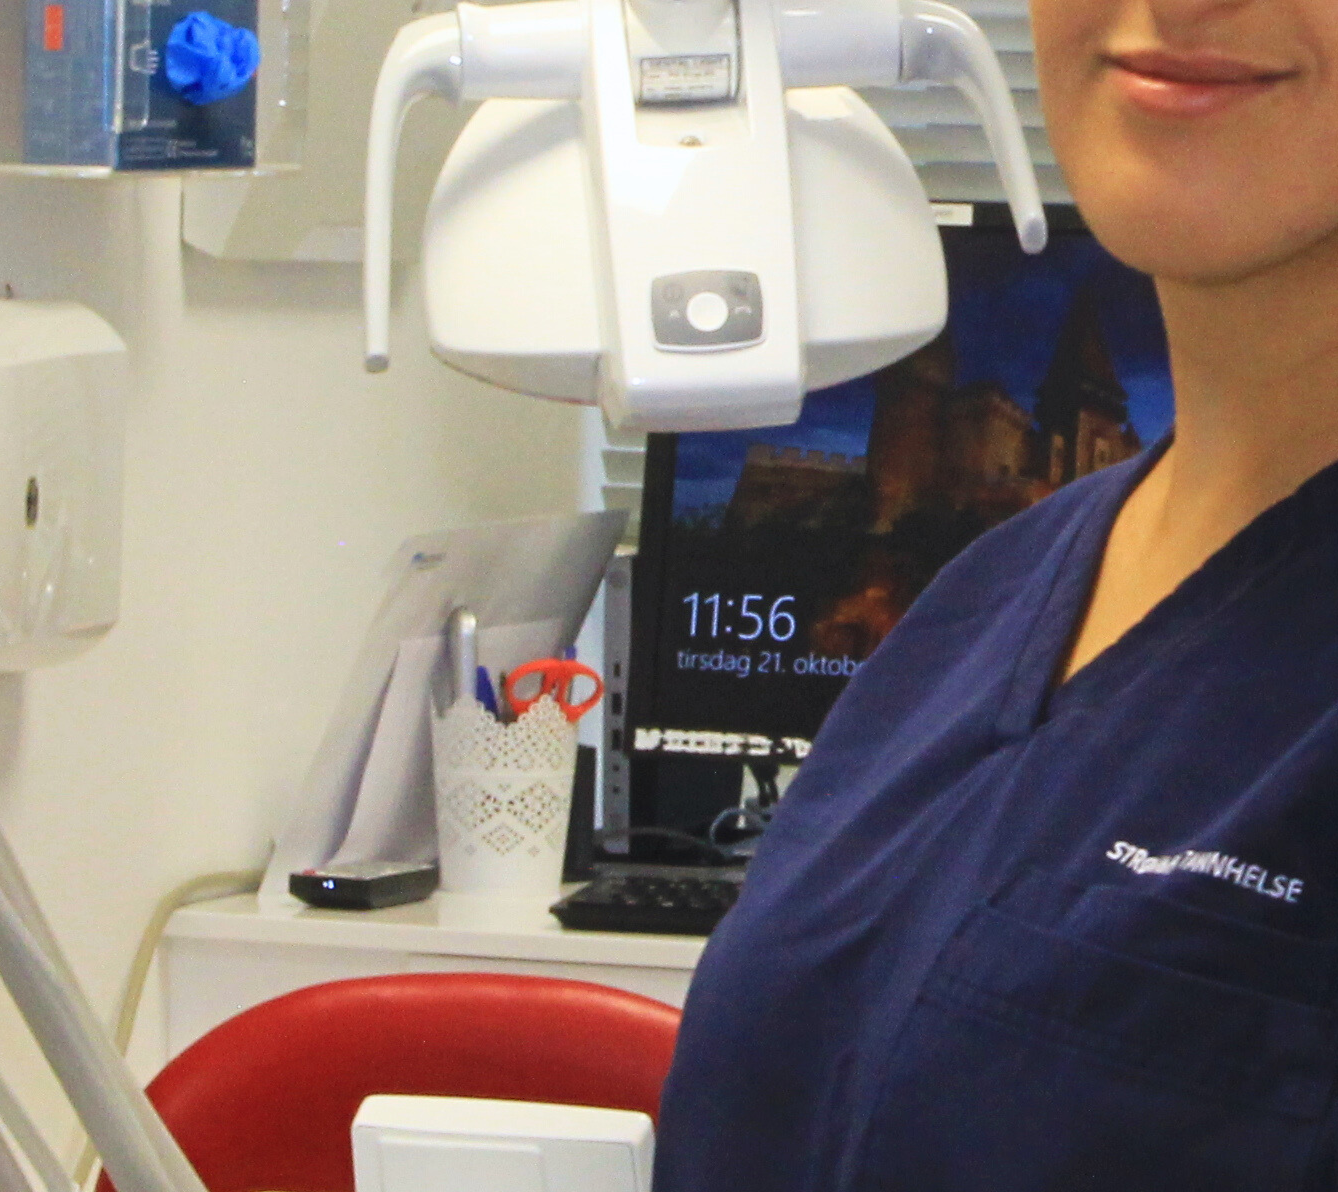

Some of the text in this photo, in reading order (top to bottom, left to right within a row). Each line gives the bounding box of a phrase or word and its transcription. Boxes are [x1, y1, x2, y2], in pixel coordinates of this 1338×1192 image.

[682, 592, 797, 642] 11:56
[676, 650, 751, 678] tirsdag
[757, 651, 786, 673] 21.
